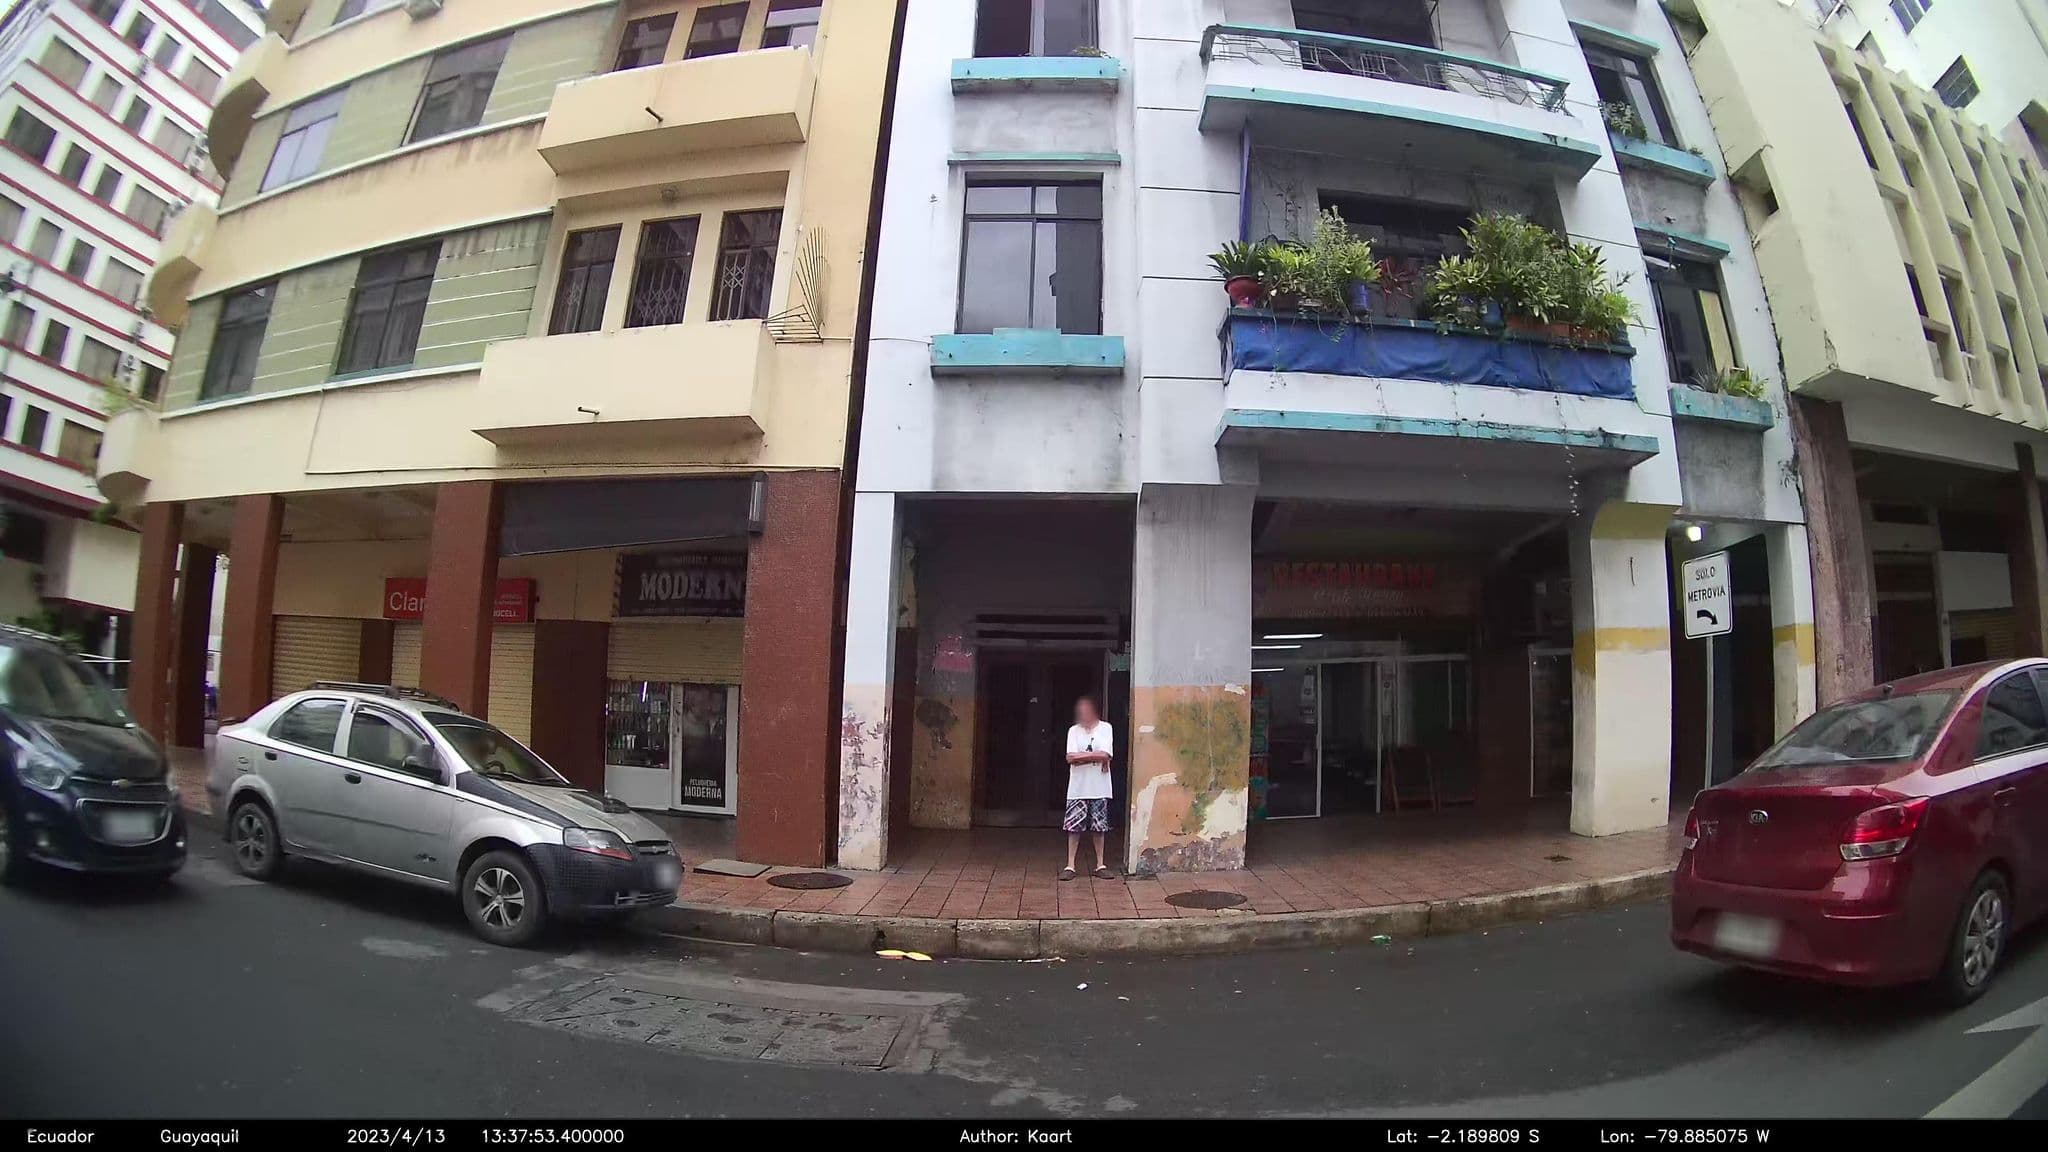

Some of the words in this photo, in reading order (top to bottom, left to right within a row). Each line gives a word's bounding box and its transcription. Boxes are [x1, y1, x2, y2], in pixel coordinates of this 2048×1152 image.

[1695, 566, 1716, 580] SOLO
[639, 570, 744, 601] MODERN
[1687, 585, 1726, 603] METROVIA
[390, 591, 424, 612] Clar
[684, 786, 722, 799] MODERNA
